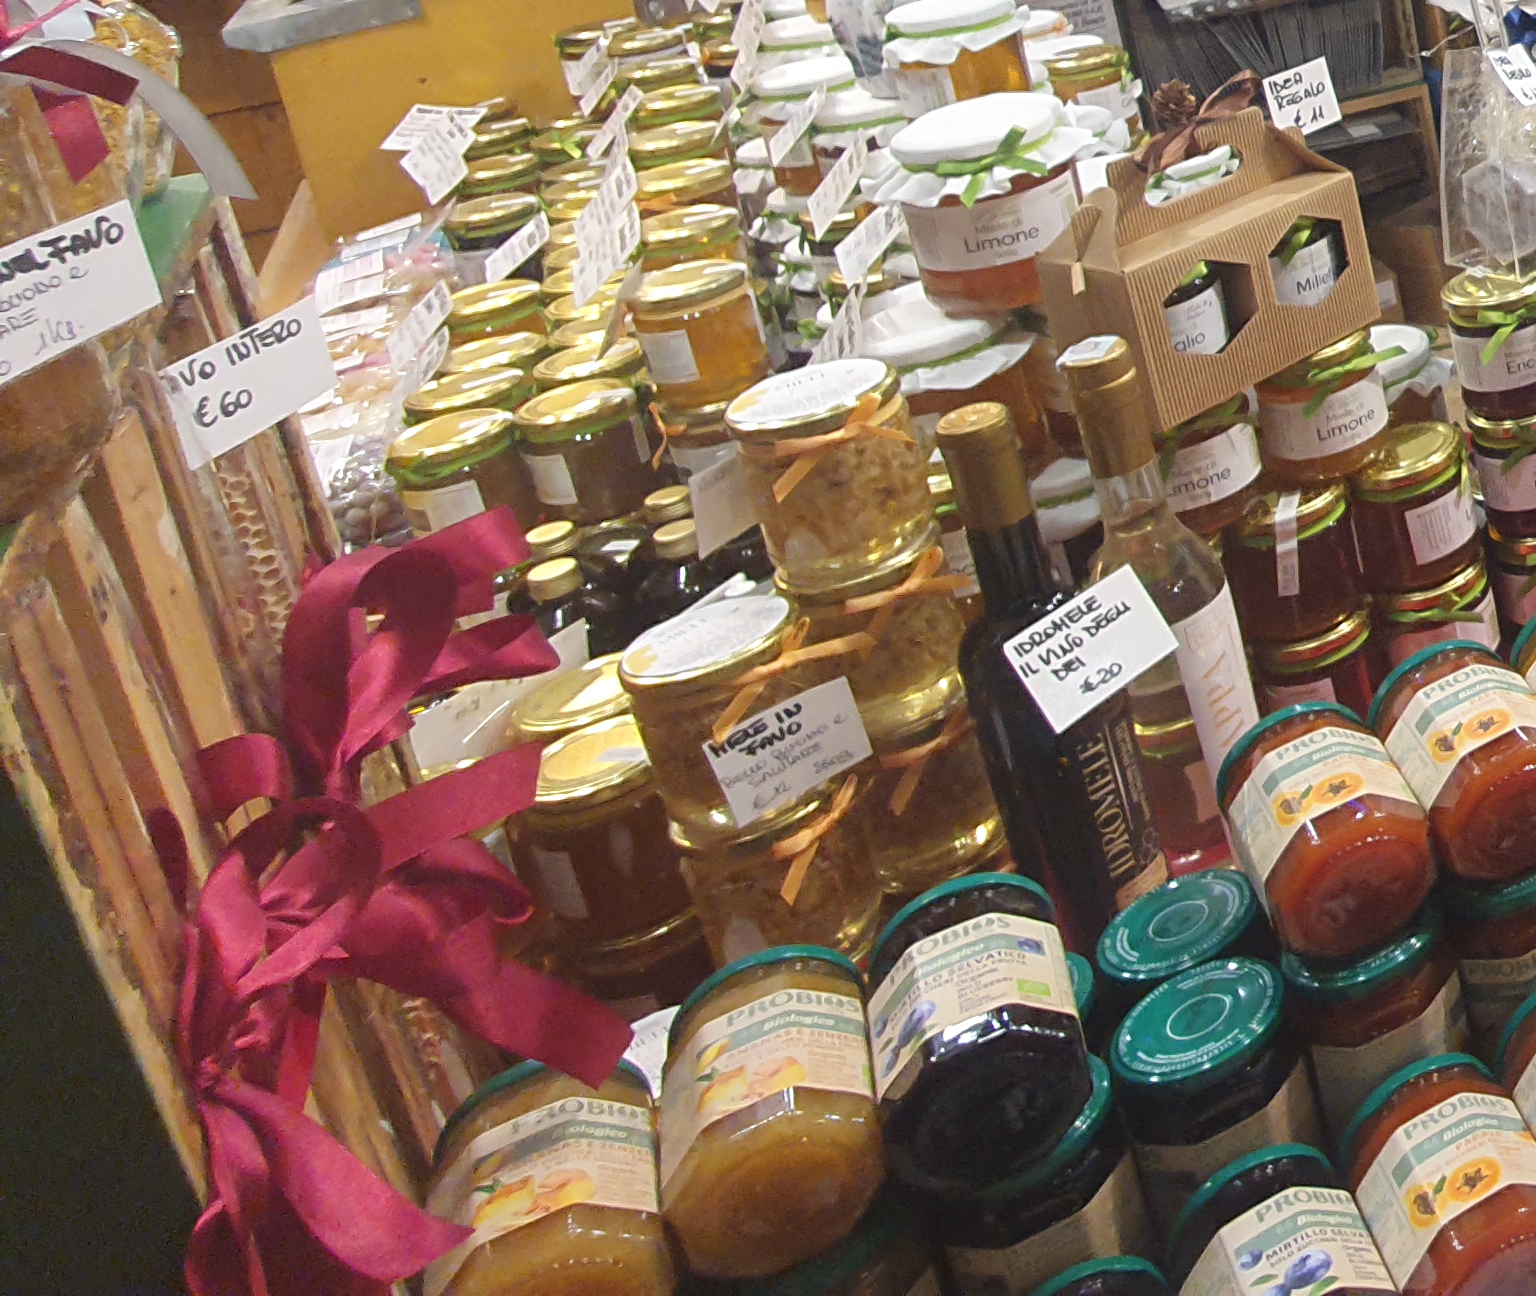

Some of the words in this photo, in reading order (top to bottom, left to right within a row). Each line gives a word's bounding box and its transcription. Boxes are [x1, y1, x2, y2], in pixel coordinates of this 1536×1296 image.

[1269, 72, 1304, 97] IDEA
[1273, 81, 1326, 111] REGALO
[39, 215, 125, 265] FAVO
[963, 224, 1041, 255] Limone
[225, 318, 303, 366] INTERO
[1316, 407, 1377, 442] Limone
[1012, 594, 1103, 658] IDROMELE
[1018, 662, 1042, 679] IL
[1042, 635, 1085, 667] VINO
[1081, 601, 1132, 640] DEGLI
[1051, 657, 1087, 684] DEI
[774, 702, 803, 724] IN
[738, 721, 803, 757] FAVO
[1076, 731, 1136, 881] IDROMELE
[726, 990, 861, 1028] PROBIOS
[1402, 1093, 1509, 1142] PROBIOS
[1254, 1189, 1351, 1225] PROBIO
[1265, 1228, 1329, 1262] MIRTILLO
[1330, 1228, 1370, 1240] SELVA
